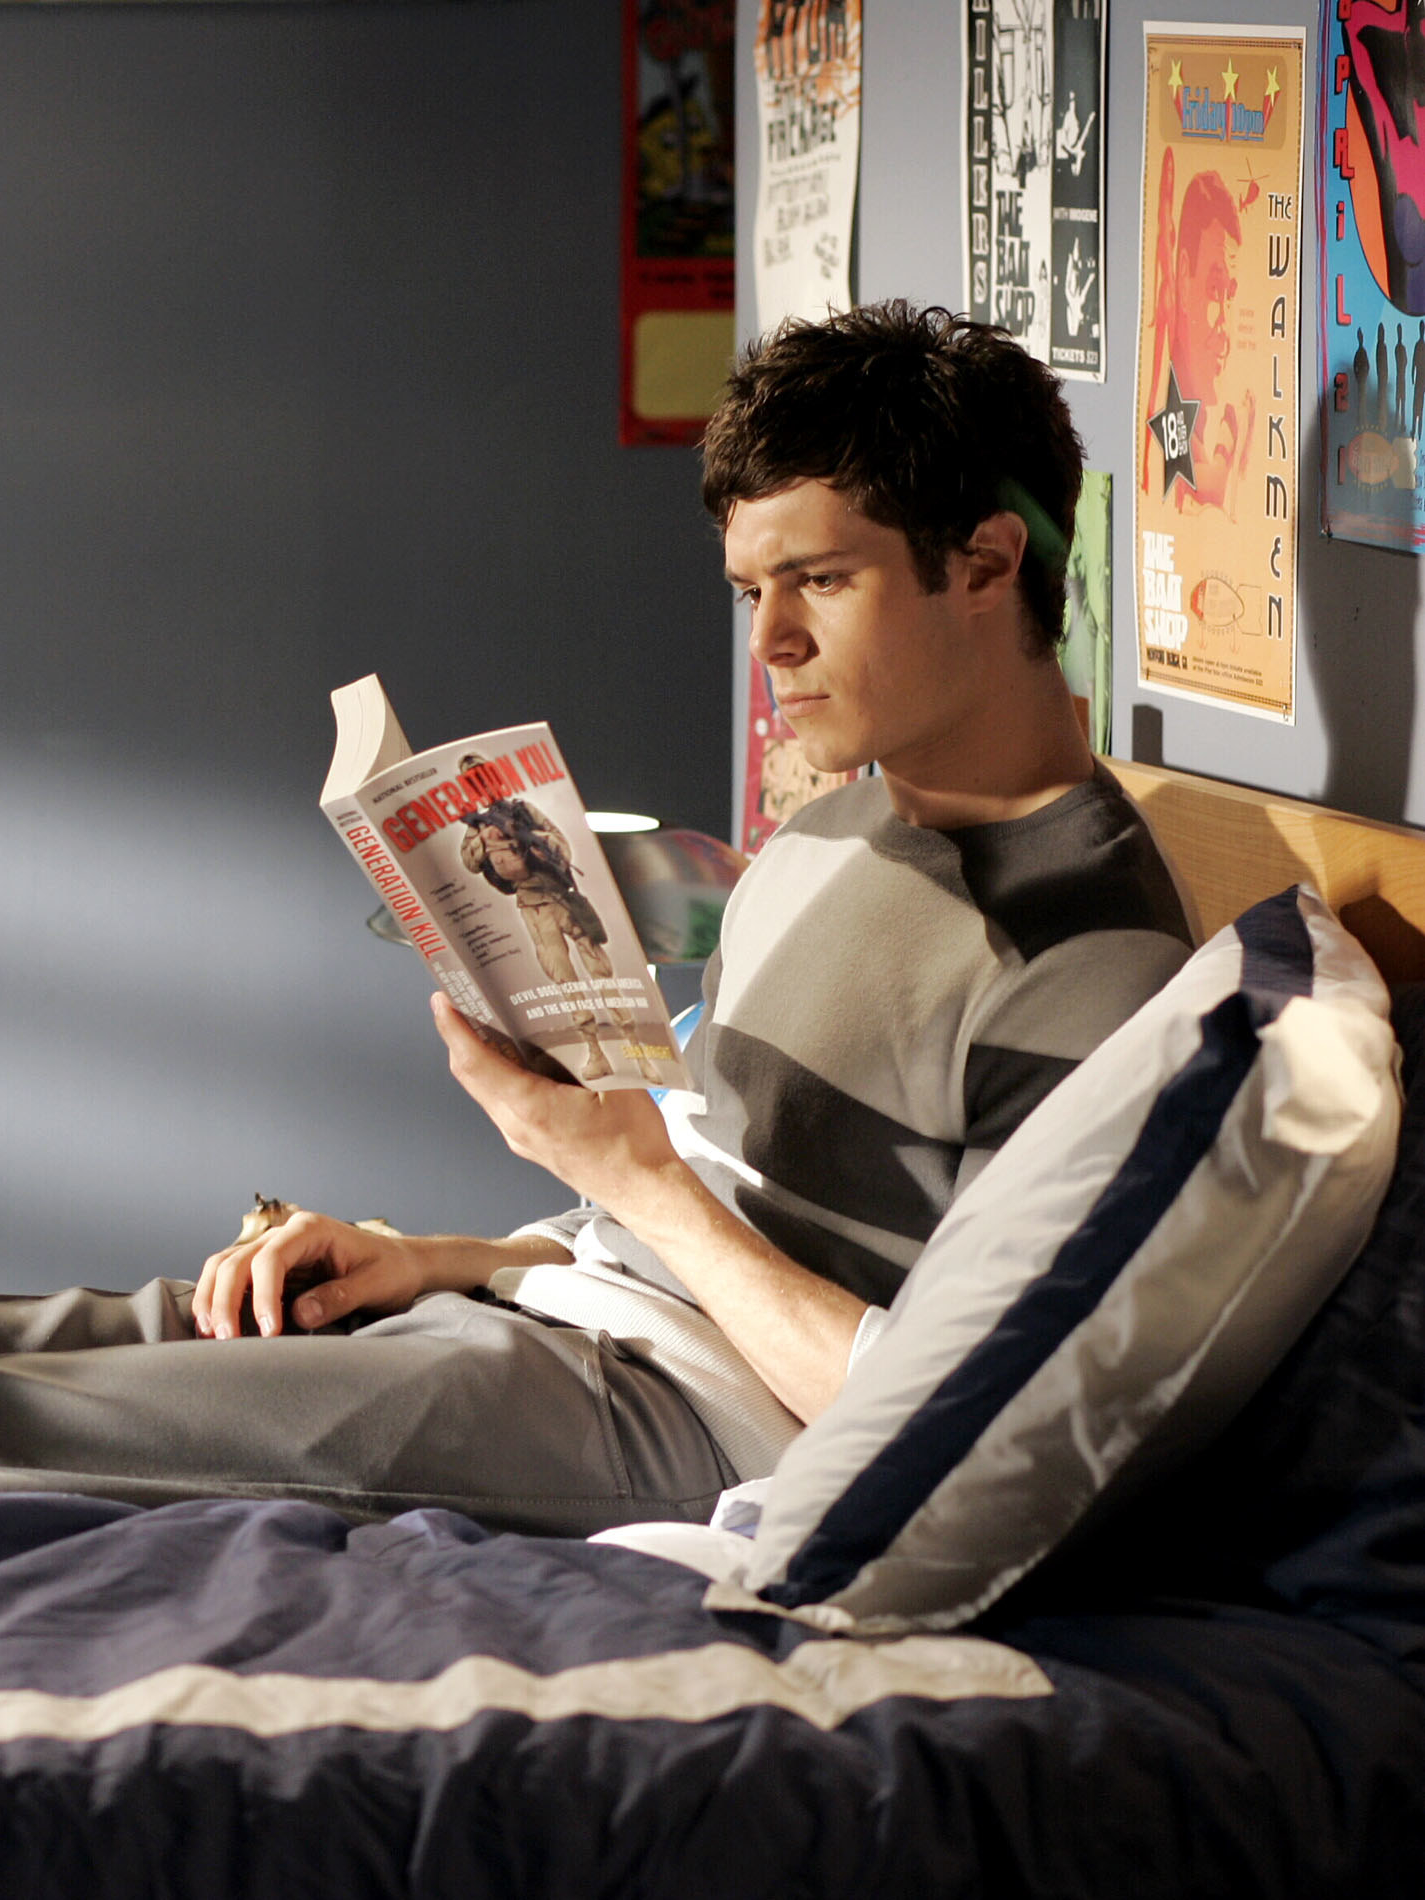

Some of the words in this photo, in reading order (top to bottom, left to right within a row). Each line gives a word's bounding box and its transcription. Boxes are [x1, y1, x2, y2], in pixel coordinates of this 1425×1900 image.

[1182, 86, 1225, 141] Friday
[971, 0, 990, 304] ILLERS
[1268, 194, 1292, 220] THE
[1162, 412, 1179, 461] 18
[1142, 530, 1175, 572] THE
[1143, 568, 1183, 612] BAIT
[1143, 607, 1188, 651] SHOP
[382, 755, 522, 853] GENERATION
[519, 741, 565, 789] KILL
[346, 825, 421, 927] GENERATION
[409, 920, 446, 959] KILL
[510, 988, 538, 1006] DEVIL
[526, 1007, 545, 1020] AND
[544, 1003, 561, 1016] THE
[560, 1001, 578, 1013] NEW
